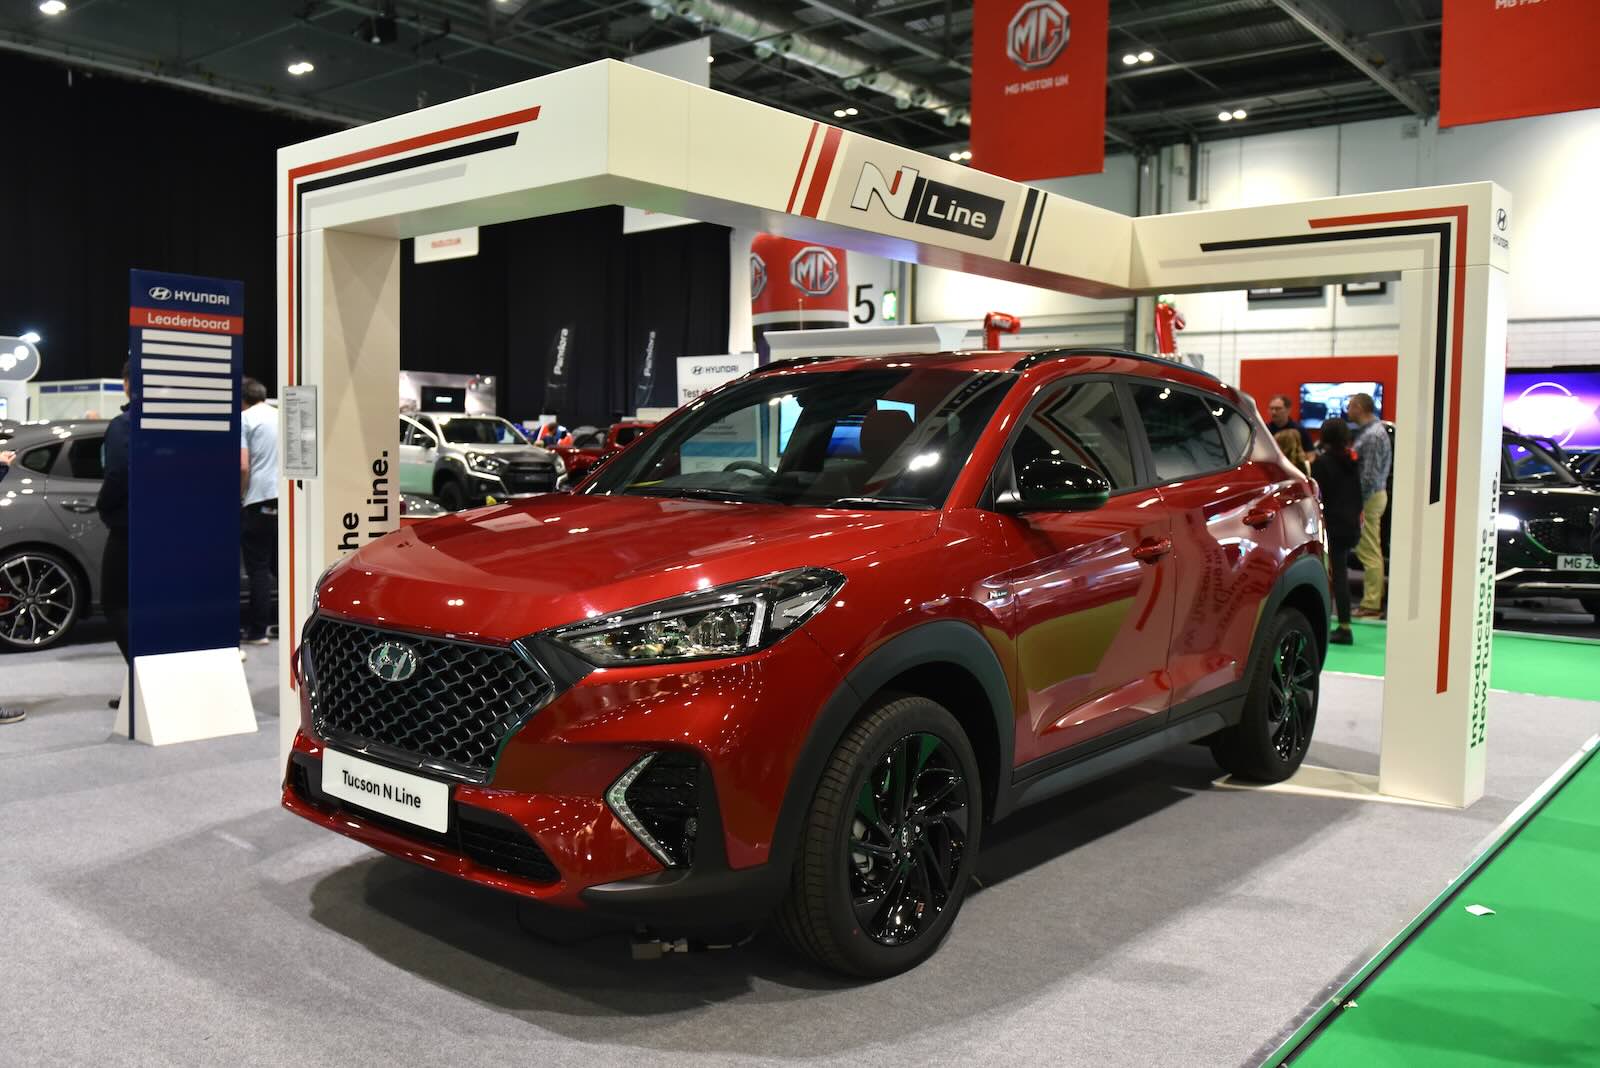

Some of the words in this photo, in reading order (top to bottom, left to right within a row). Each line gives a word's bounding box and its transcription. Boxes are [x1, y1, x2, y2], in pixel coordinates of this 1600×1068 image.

[1013, 5, 1063, 61] MG
[1005, 83, 1019, 95] MG
[1021, 78, 1053, 92] MOTOR
[850, 161, 919, 220] N
[927, 194, 987, 229] Line
[797, 252, 835, 291] MG
[174, 290, 230, 305] HYUNDAI
[854, 284, 875, 324] 5
[147, 312, 230, 330] Leaderboard
[553, 328, 568, 375] Pandora
[643, 331, 656, 376] Pandora
[705, 365, 738, 373] HYUNDAI
[683, 388, 700, 398] Test
[366, 450, 388, 522] Line.
[337, 512, 359, 553] he
[1487, 546, 1494, 566] N
[1564, 558, 1582, 569] MG
[1470, 583, 1486, 748] Introducing
[1479, 528, 1488, 574] the
[1481, 575, 1492, 676] Tucson
[1478, 680, 1487, 743] New
[342, 769, 380, 796] Tucson
[383, 783, 393, 799] N
[395, 787, 421, 808] Line
